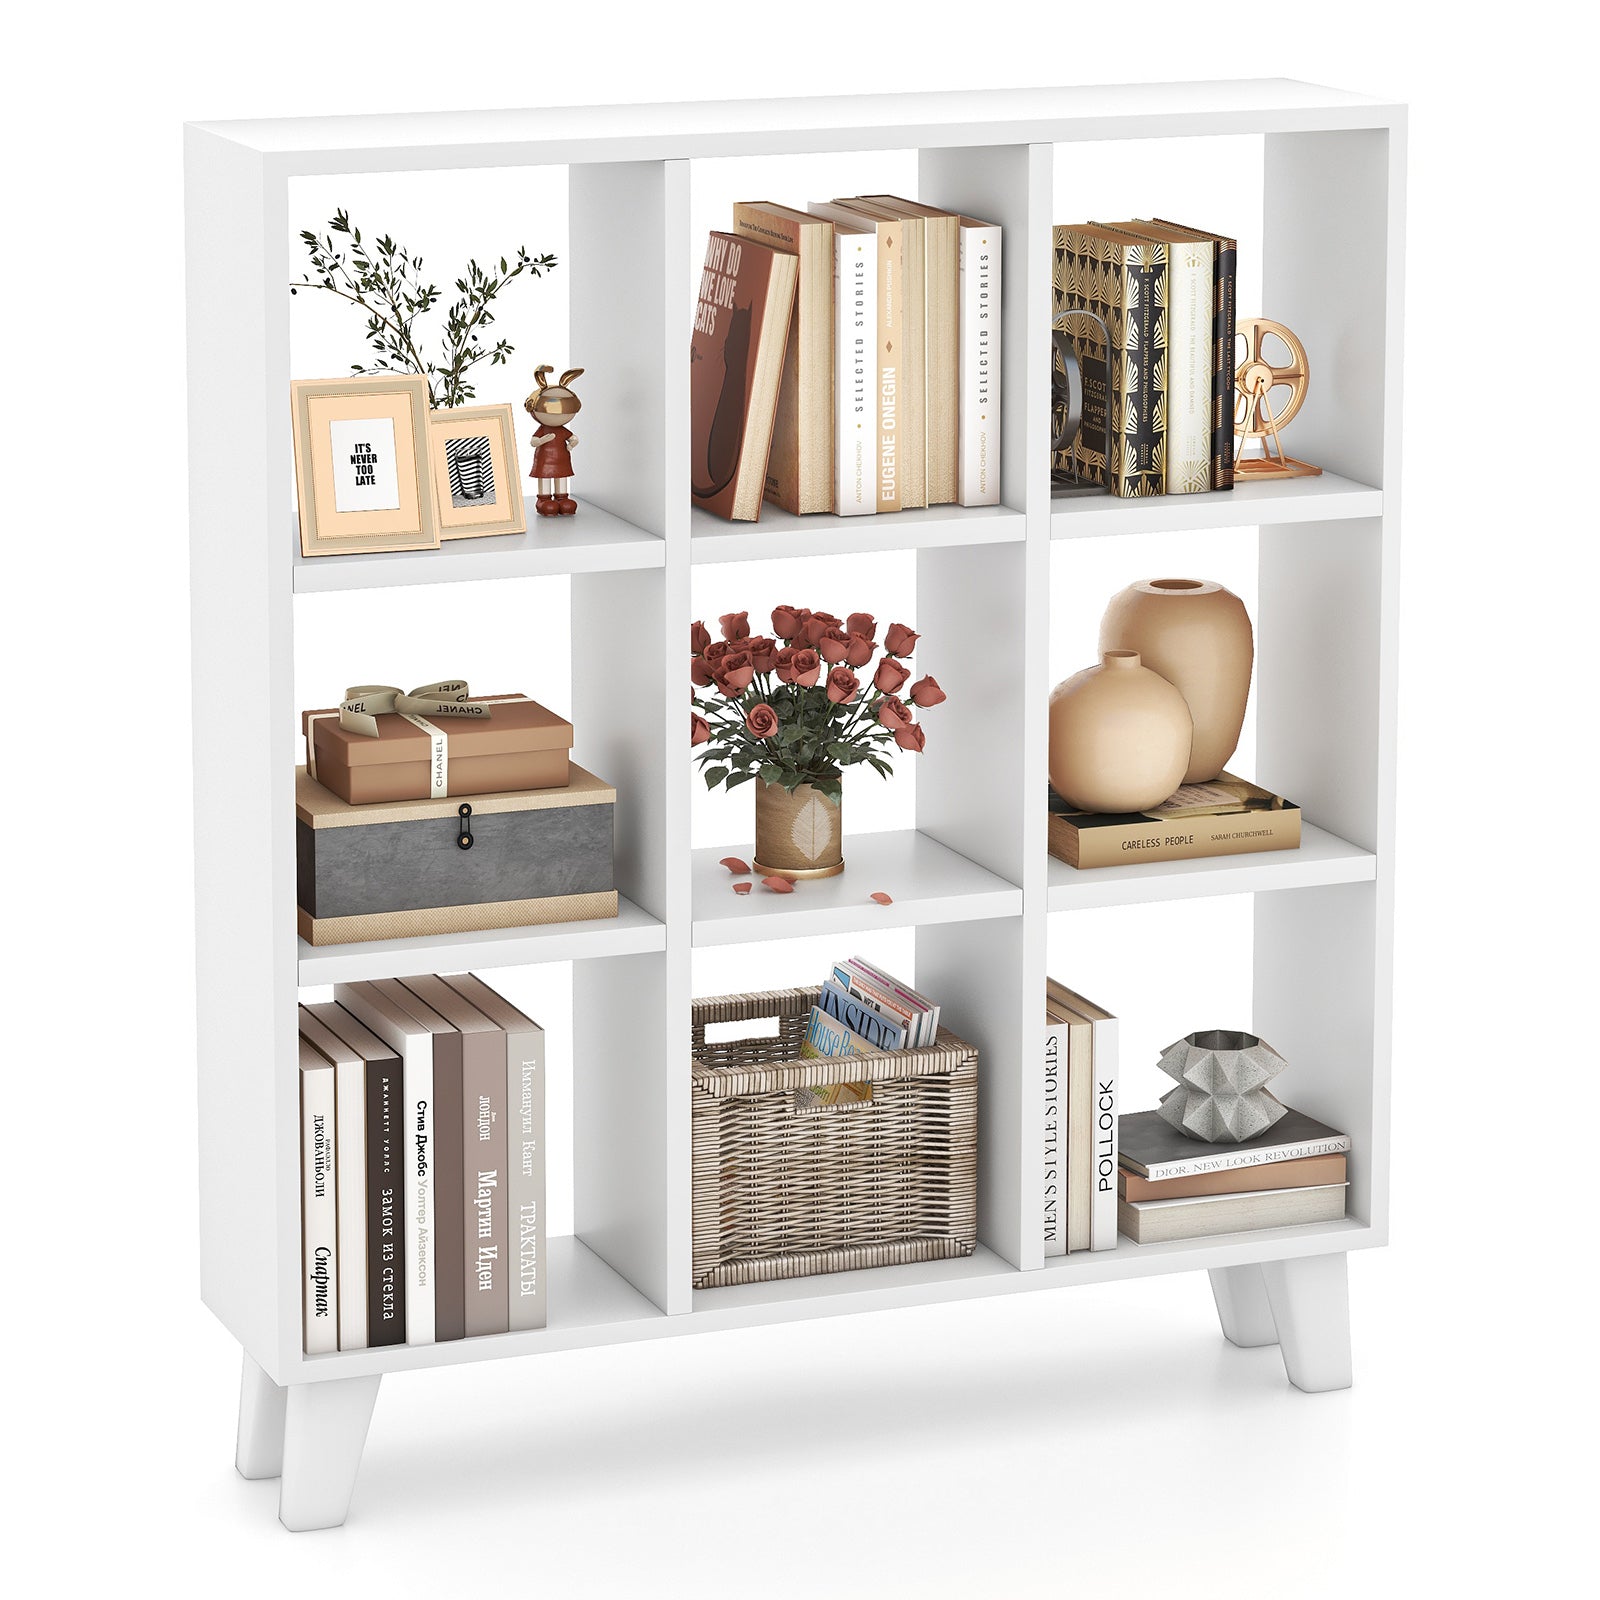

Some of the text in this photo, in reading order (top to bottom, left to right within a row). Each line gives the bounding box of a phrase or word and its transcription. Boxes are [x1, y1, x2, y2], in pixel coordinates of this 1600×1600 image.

[704, 235, 742, 278] WHY DO
[700, 270, 737, 309] WE LOVE
[694, 301, 717, 336] CATS
[855, 262, 864, 412] SELECTED STORIES
[979, 254, 989, 404] SELECTED STORIES
[350, 453, 378, 465] NEVER
[354, 443, 371, 454] IT'S
[882, 367, 896, 501] EUGENE ONEGIN
[355, 475, 376, 487] LATE
[356, 464, 374, 476] TOO
[343, 702, 367, 714] NEL
[435, 738, 443, 788] CHANEL
[1121, 835, 1194, 851] CARELESS PEOPLE
[1210, 829, 1274, 841] SARAH CHURCHWELL
[818, 987, 897, 1052] INSIDE
[1045, 1035, 1058, 1116] STORIES
[415, 1100, 427, 1177] Стив Джобс
[477, 1095, 490, 1141] ЛОНДОН
[520, 1060, 536, 1177] Иммануил Кант
[1099, 1079, 1114, 1192] POLLOCK
[313, 1115, 325, 1197] ДЖОВАНЬОЛИ
[1045, 1121, 1058, 1180] STYLE
[1155, 1141, 1347, 1178] DIOR. NEW LOOK REVOLUTION
[382, 1243, 393, 1261] из
[416, 1179, 429, 1287] Уолтер Айзексон
[473, 1169, 498, 1291] Мартин Иден
[520, 1200, 536, 1297] ТРАКТАТЫ
[310, 1246, 331, 1318] Спартак
[382, 1268, 394, 1321] стекла
